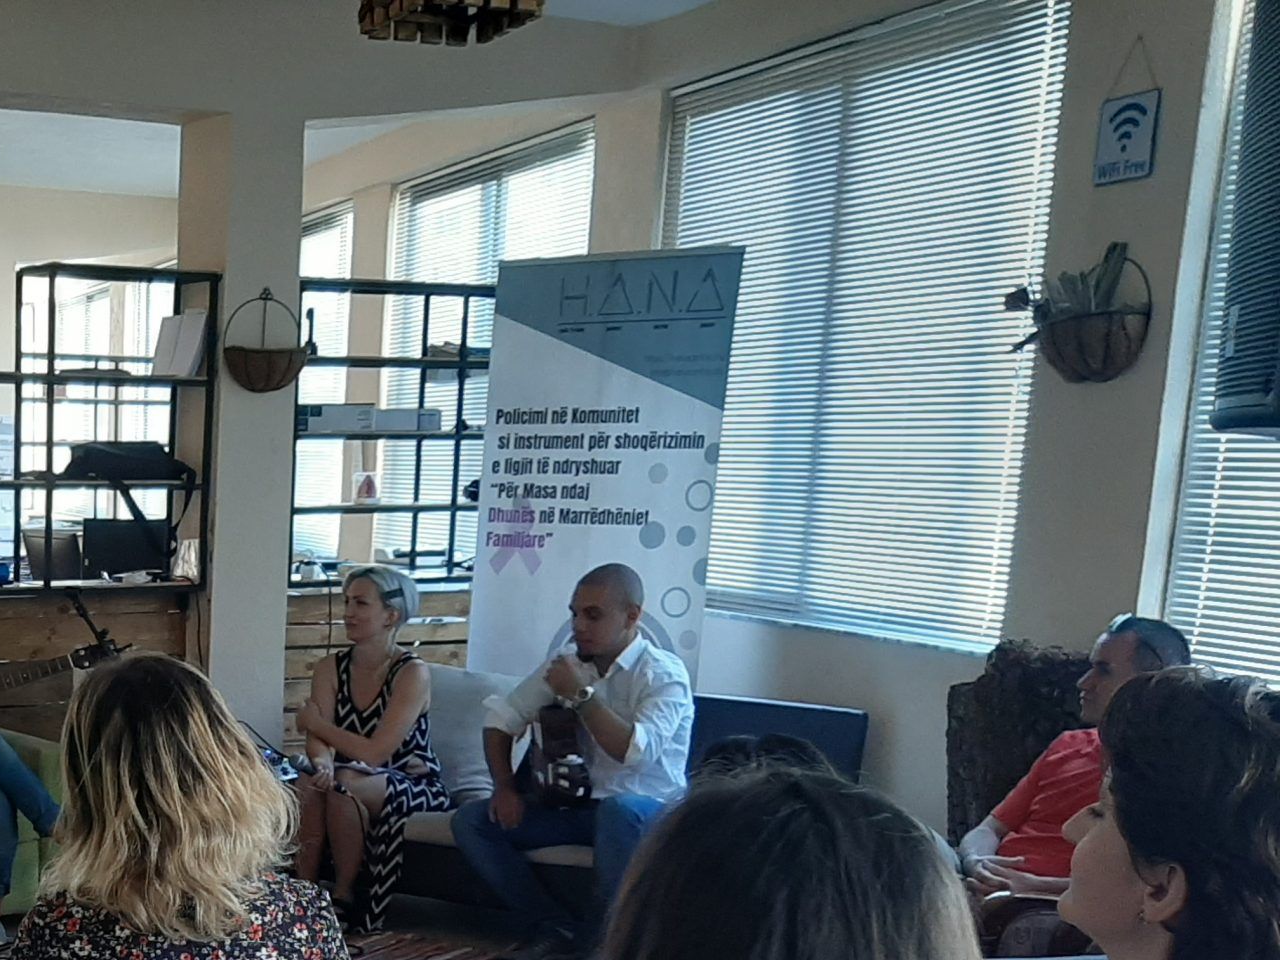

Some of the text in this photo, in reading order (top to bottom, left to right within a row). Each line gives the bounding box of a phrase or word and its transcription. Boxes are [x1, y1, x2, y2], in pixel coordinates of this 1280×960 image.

[495, 406, 640, 425] Policimi në Komunitet
[497, 431, 706, 452] si instrument për shoqërizimin
[491, 456, 622, 477] e ligjit të ndryshuar
[521, 483, 558, 500] Masa
[560, 482, 591, 501] ndaj
[487, 506, 650, 526] Dhunës në Marrëdhëniet
